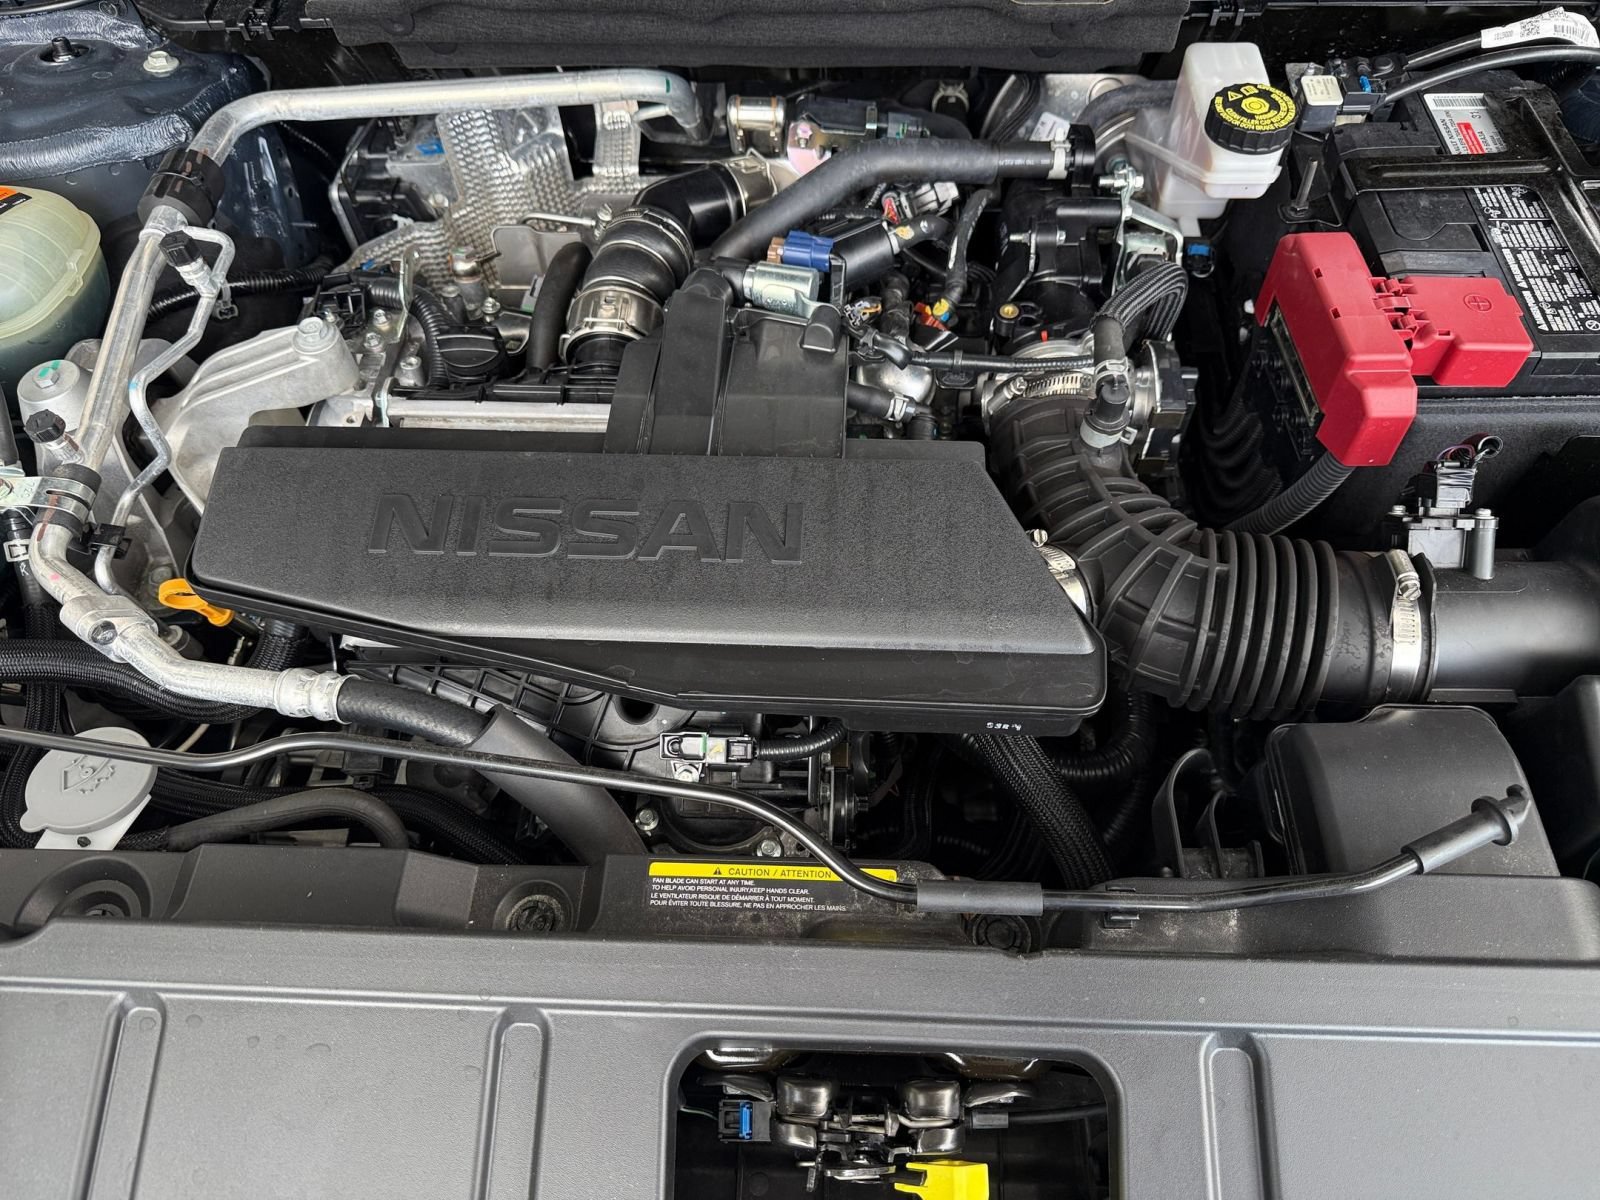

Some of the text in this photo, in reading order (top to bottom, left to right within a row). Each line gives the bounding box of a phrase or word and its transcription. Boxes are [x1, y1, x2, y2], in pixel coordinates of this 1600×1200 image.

[368, 493, 802, 566] NISSAN
[728, 867, 832, 878] CAUTION / ATTENTION
